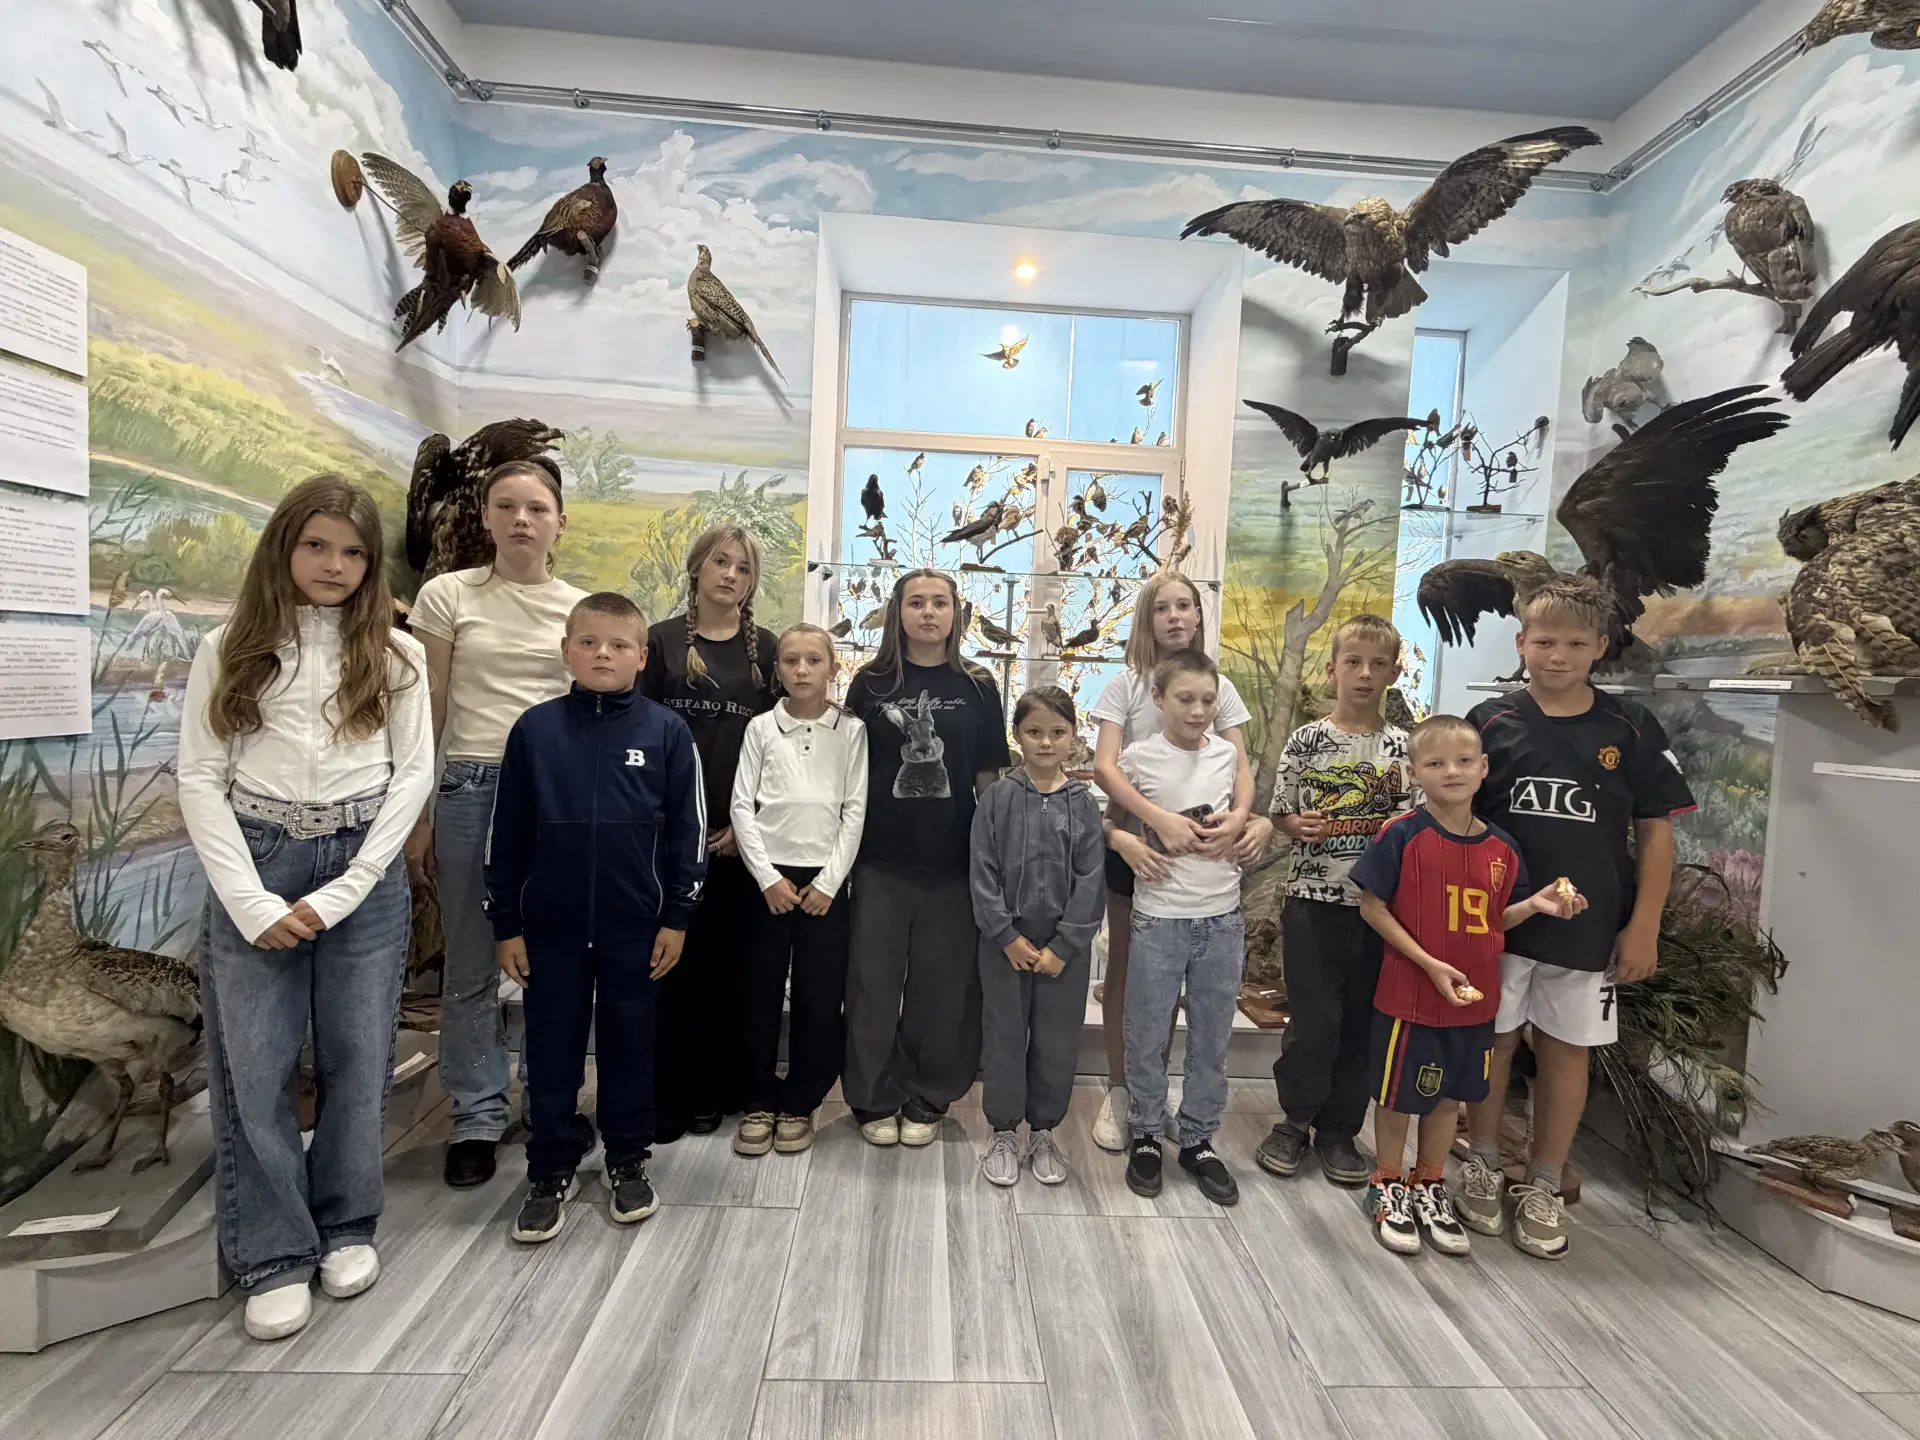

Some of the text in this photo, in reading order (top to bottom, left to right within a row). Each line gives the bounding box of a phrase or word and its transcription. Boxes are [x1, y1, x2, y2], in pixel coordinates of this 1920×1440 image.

[625, 749, 645, 767] B
[1513, 780, 1592, 817] AIG
[1446, 884, 1489, 934] 19
[1599, 985, 1615, 1021] 7
